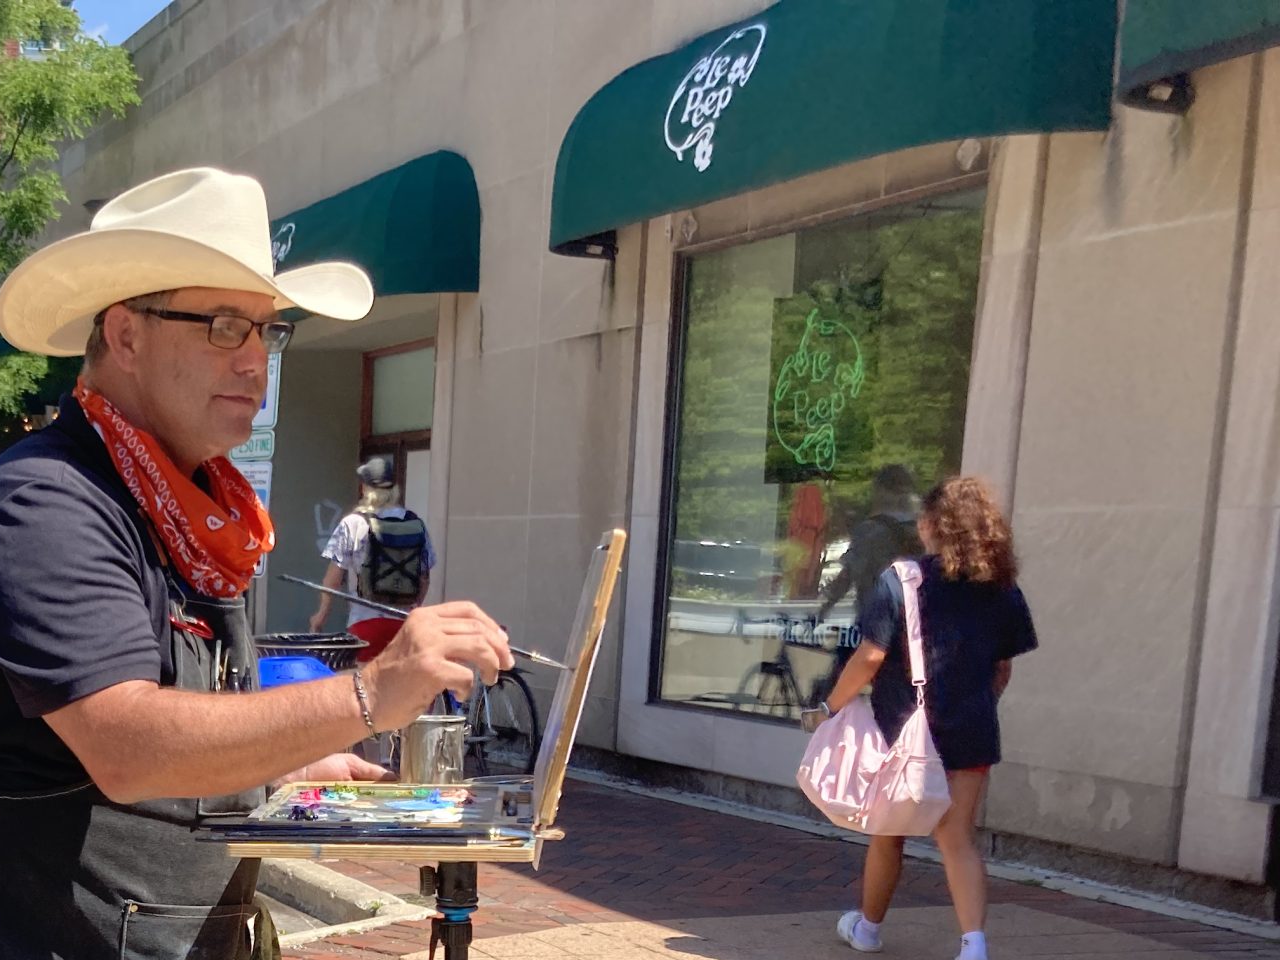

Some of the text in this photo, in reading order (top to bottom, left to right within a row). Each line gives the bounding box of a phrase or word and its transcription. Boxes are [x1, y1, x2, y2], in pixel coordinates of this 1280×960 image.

[702, 56, 731, 90] Le
[681, 86, 732, 128] Peep
[792, 391, 845, 429] Peep
